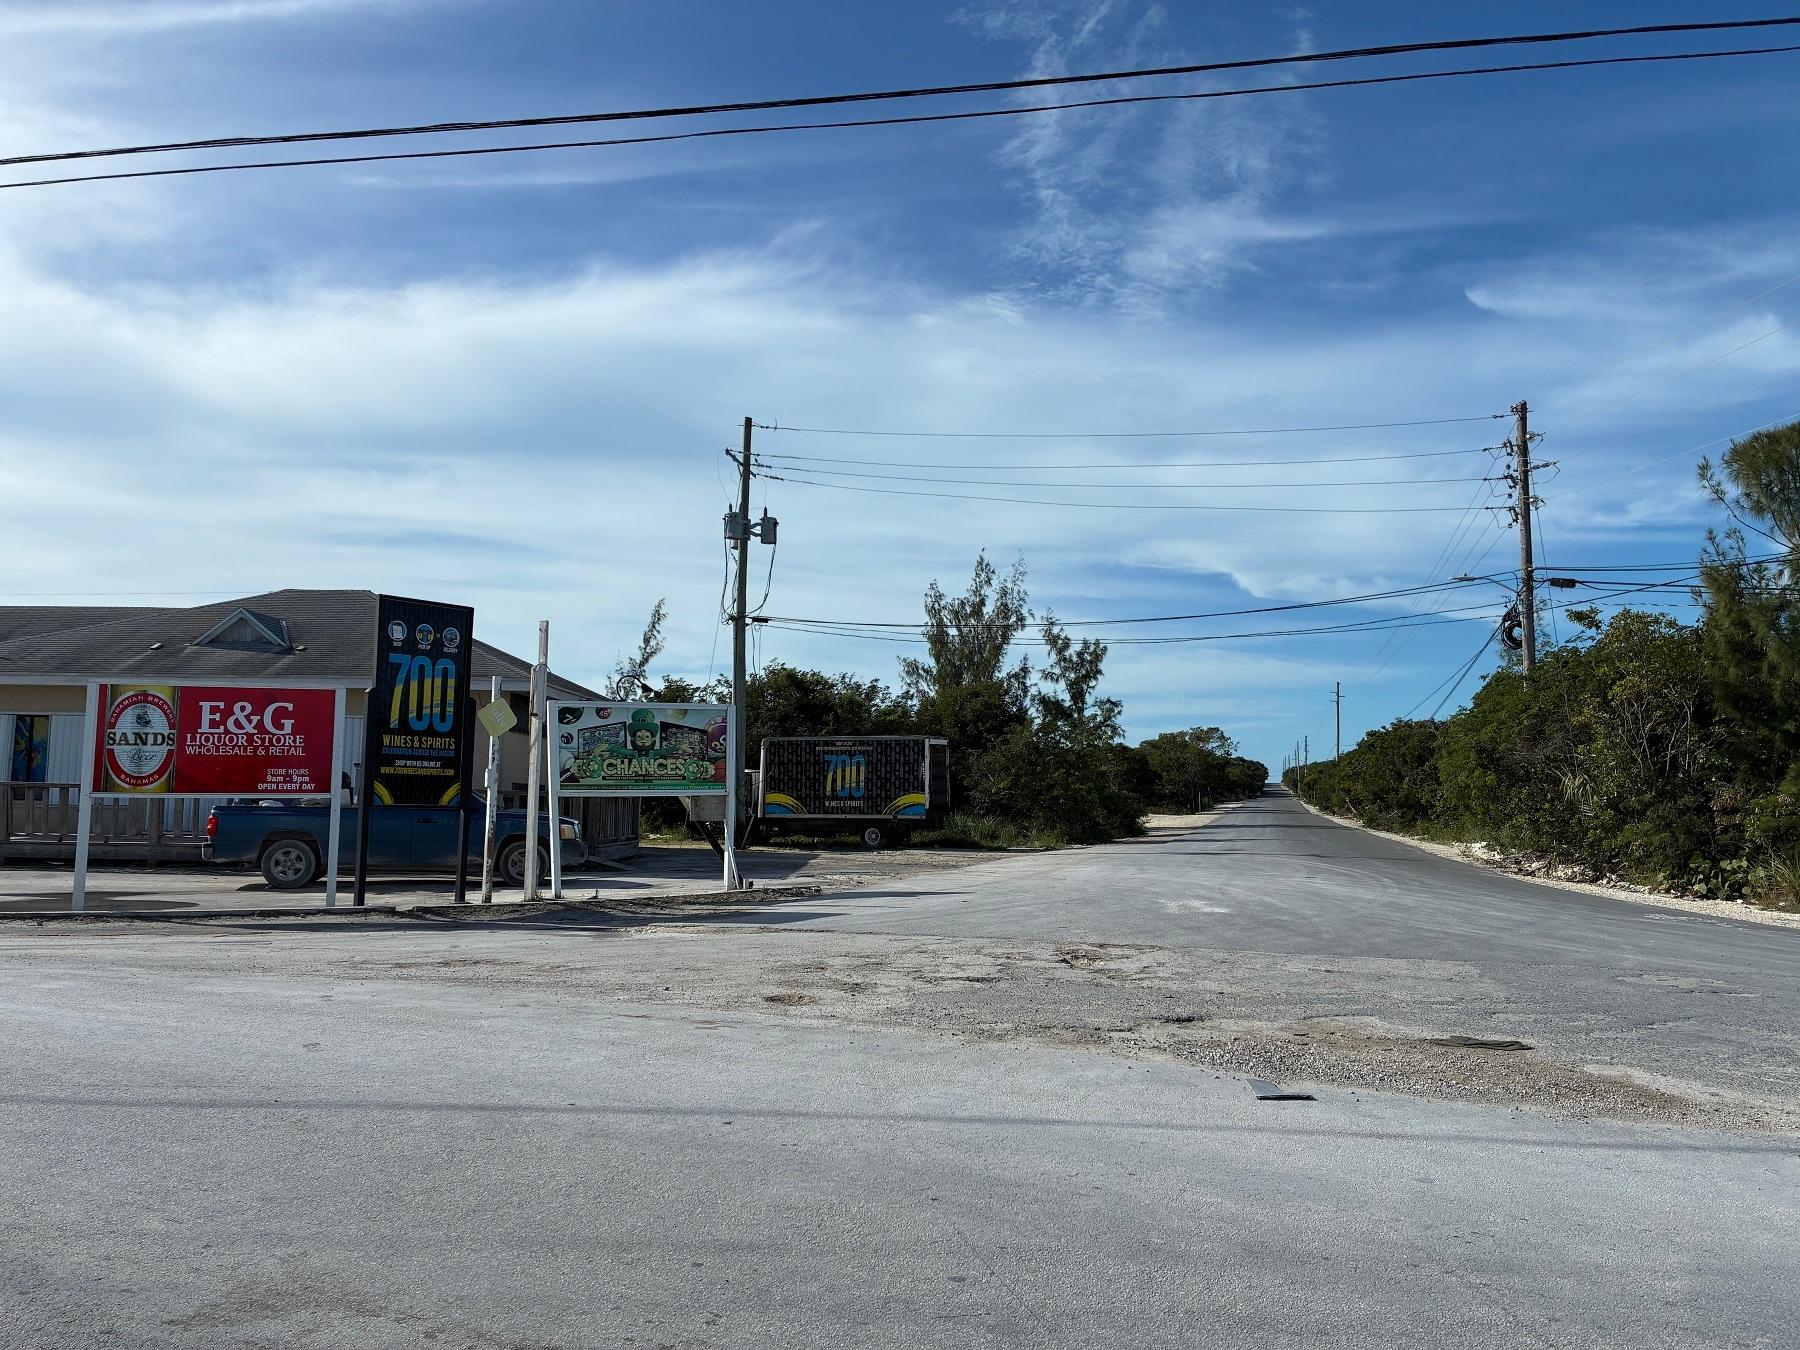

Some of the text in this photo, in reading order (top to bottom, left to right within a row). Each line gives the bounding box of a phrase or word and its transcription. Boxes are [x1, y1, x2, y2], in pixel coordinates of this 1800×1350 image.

[389, 653, 456, 732] 700
[110, 695, 175, 724] BAHAMIAN BREWERY
[197, 701, 295, 735] E&G
[106, 730, 176, 747] SANDS
[185, 733, 305, 747] LIQUOR STORE
[382, 734, 456, 750] WINES & SPIRITS
[185, 745, 306, 756] WHOLESALE & RETAIL
[395, 759, 406, 767] SHOP
[602, 758, 686, 776] CHANCES
[120, 774, 159, 785] BAHAMAS
[266, 774, 284, 782] 9am
[292, 774, 310, 783] 9pm
[824, 754, 865, 797] 700
